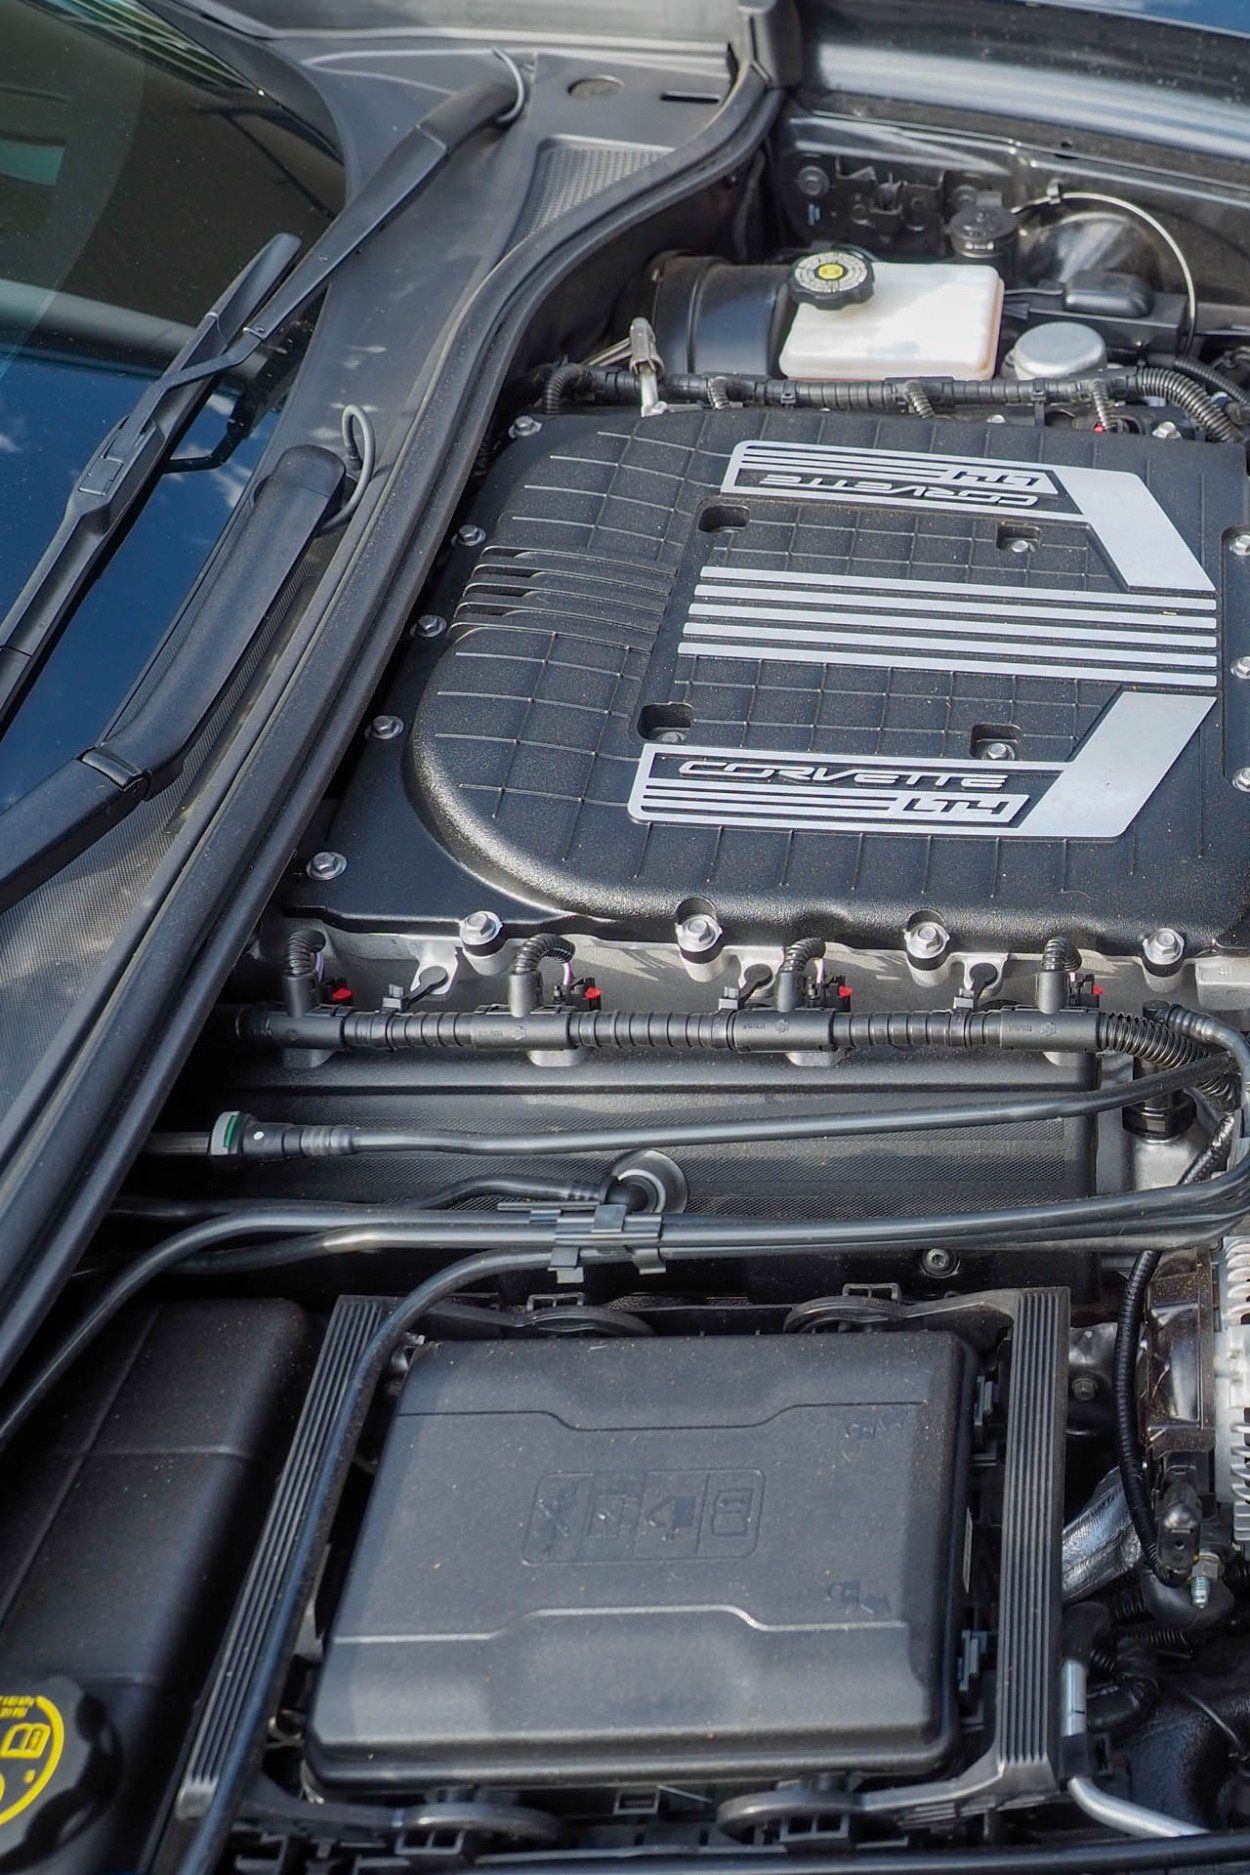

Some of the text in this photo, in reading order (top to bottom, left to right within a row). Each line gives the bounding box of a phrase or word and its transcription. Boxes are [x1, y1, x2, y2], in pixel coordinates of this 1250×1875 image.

[759, 474, 1038, 507] CORVETTE
[952, 470, 1035, 487] LT4
[678, 759, 1009, 790] CORVETTE
[902, 796, 1012, 816] LT4
